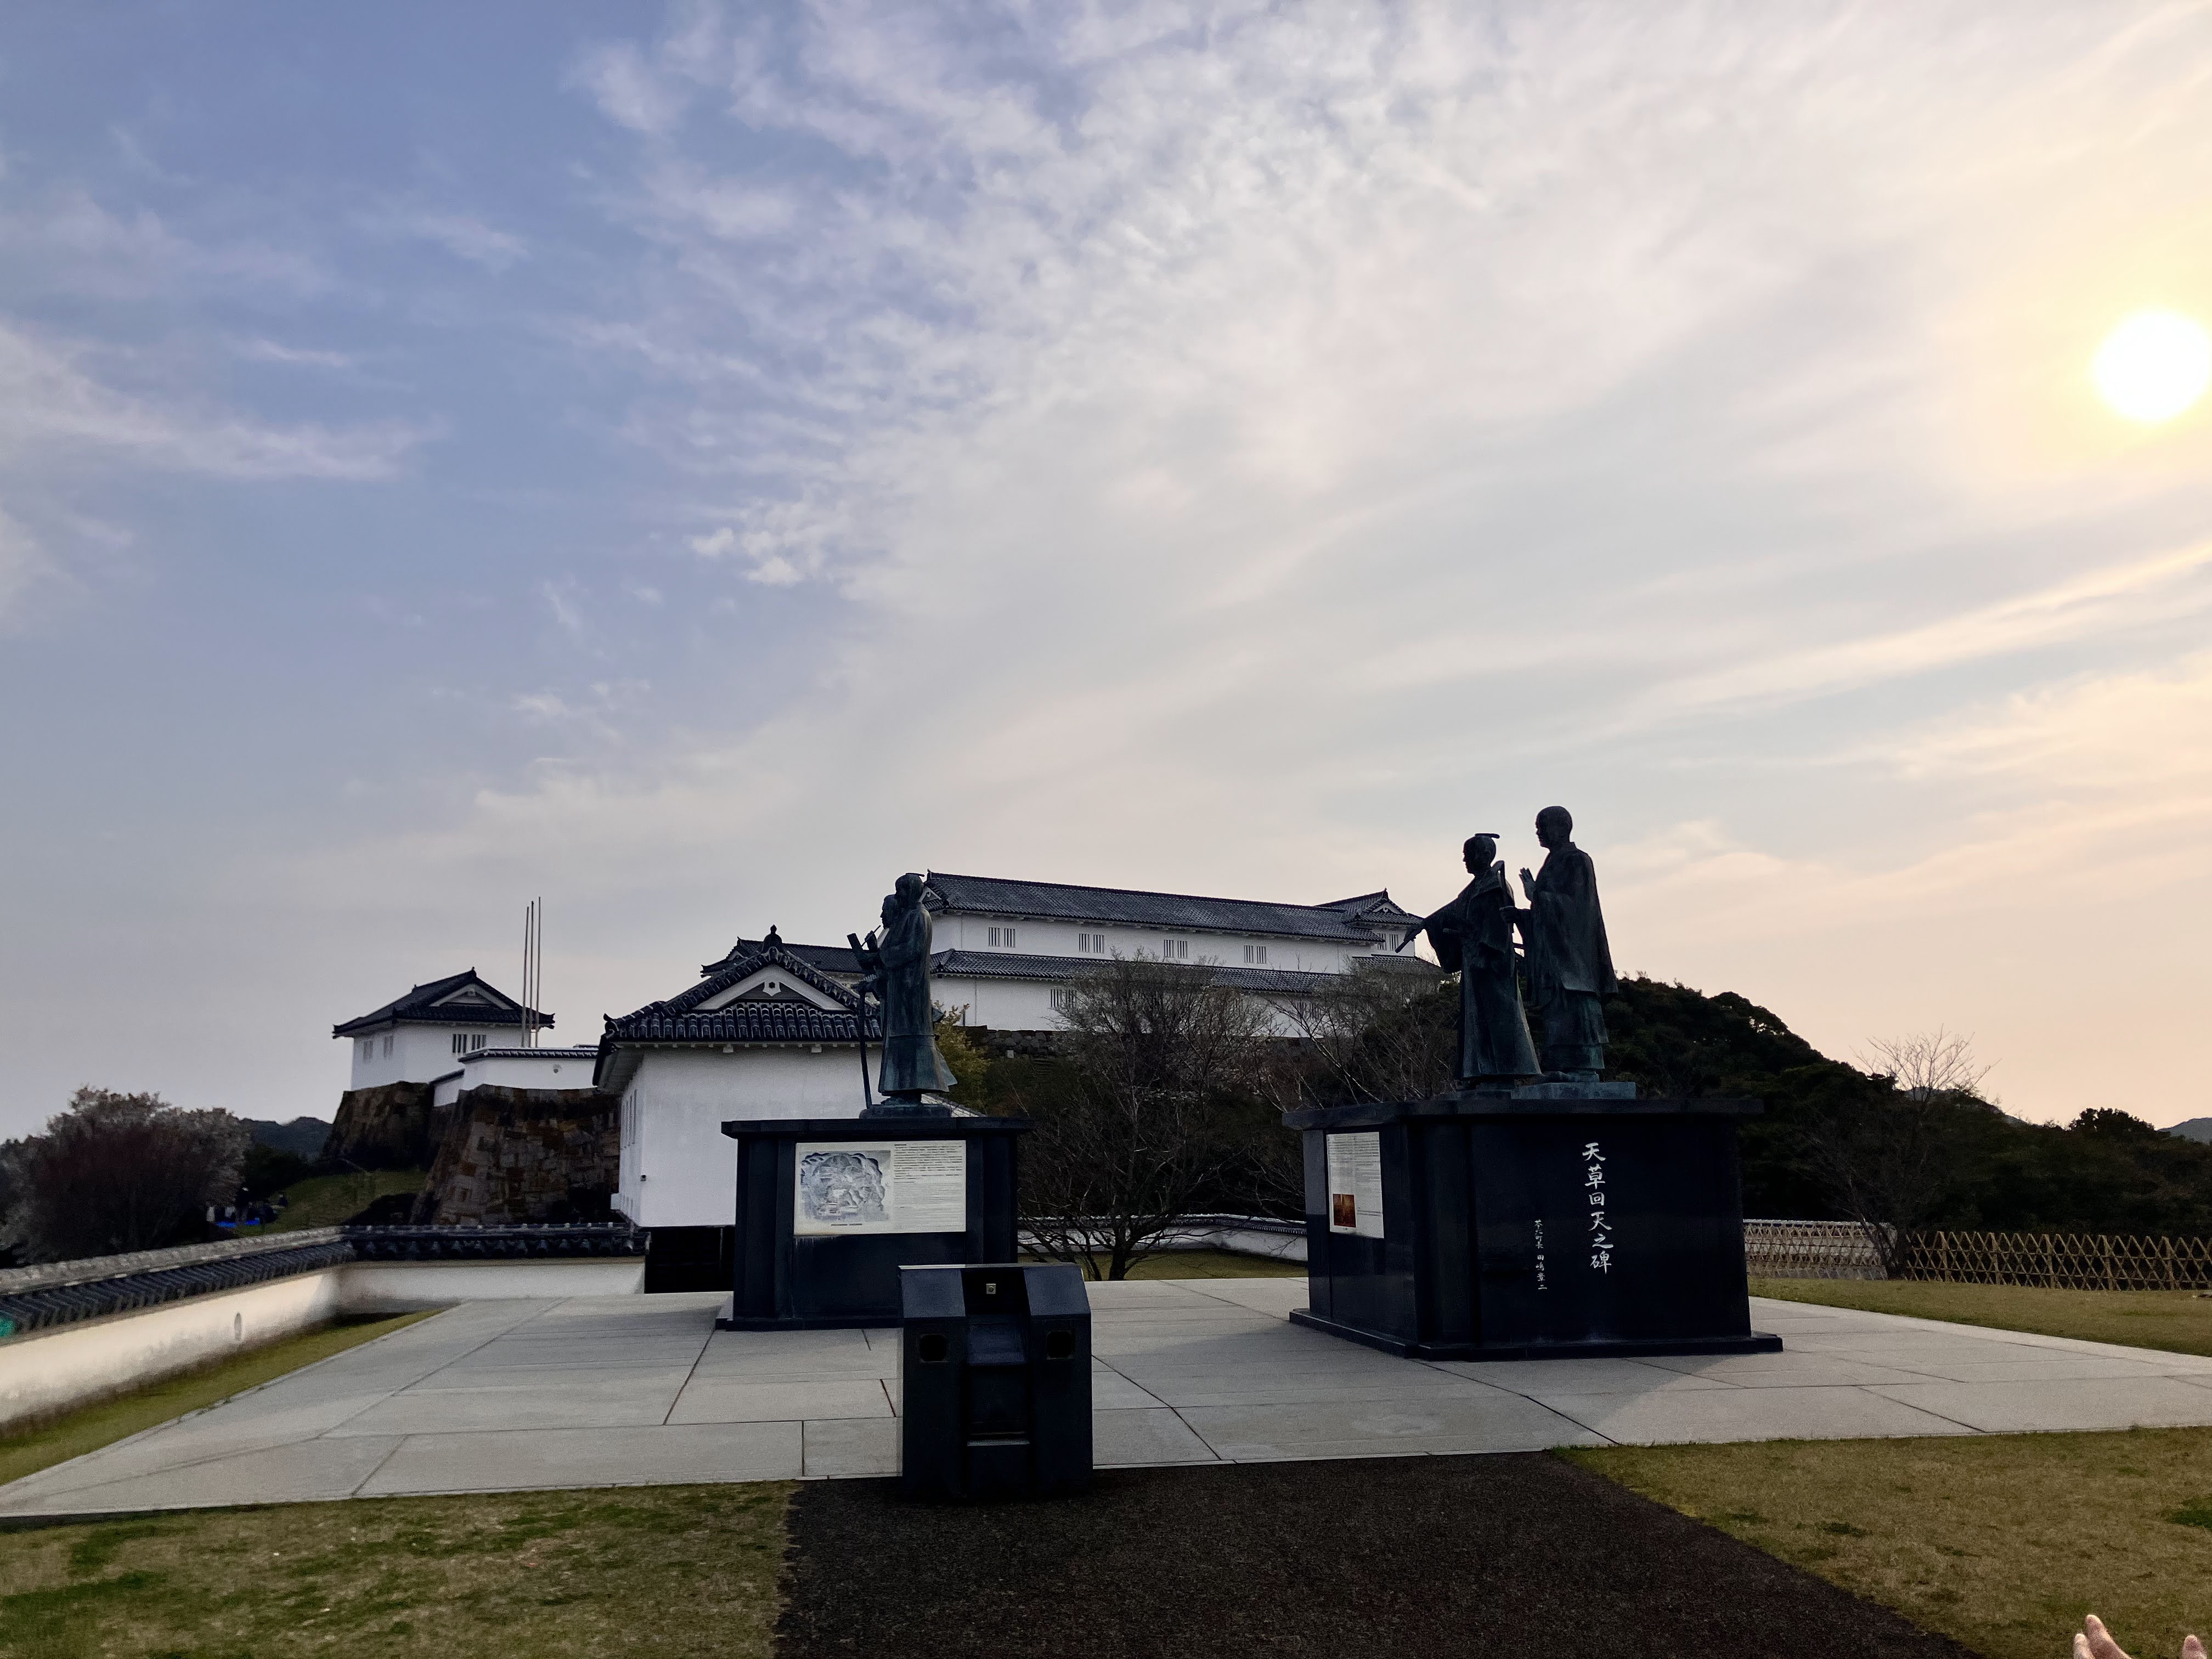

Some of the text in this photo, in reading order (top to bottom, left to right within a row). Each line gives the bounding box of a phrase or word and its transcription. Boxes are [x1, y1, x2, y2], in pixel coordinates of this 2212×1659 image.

[1582, 1142, 1613, 1274] 天草回天之碑
